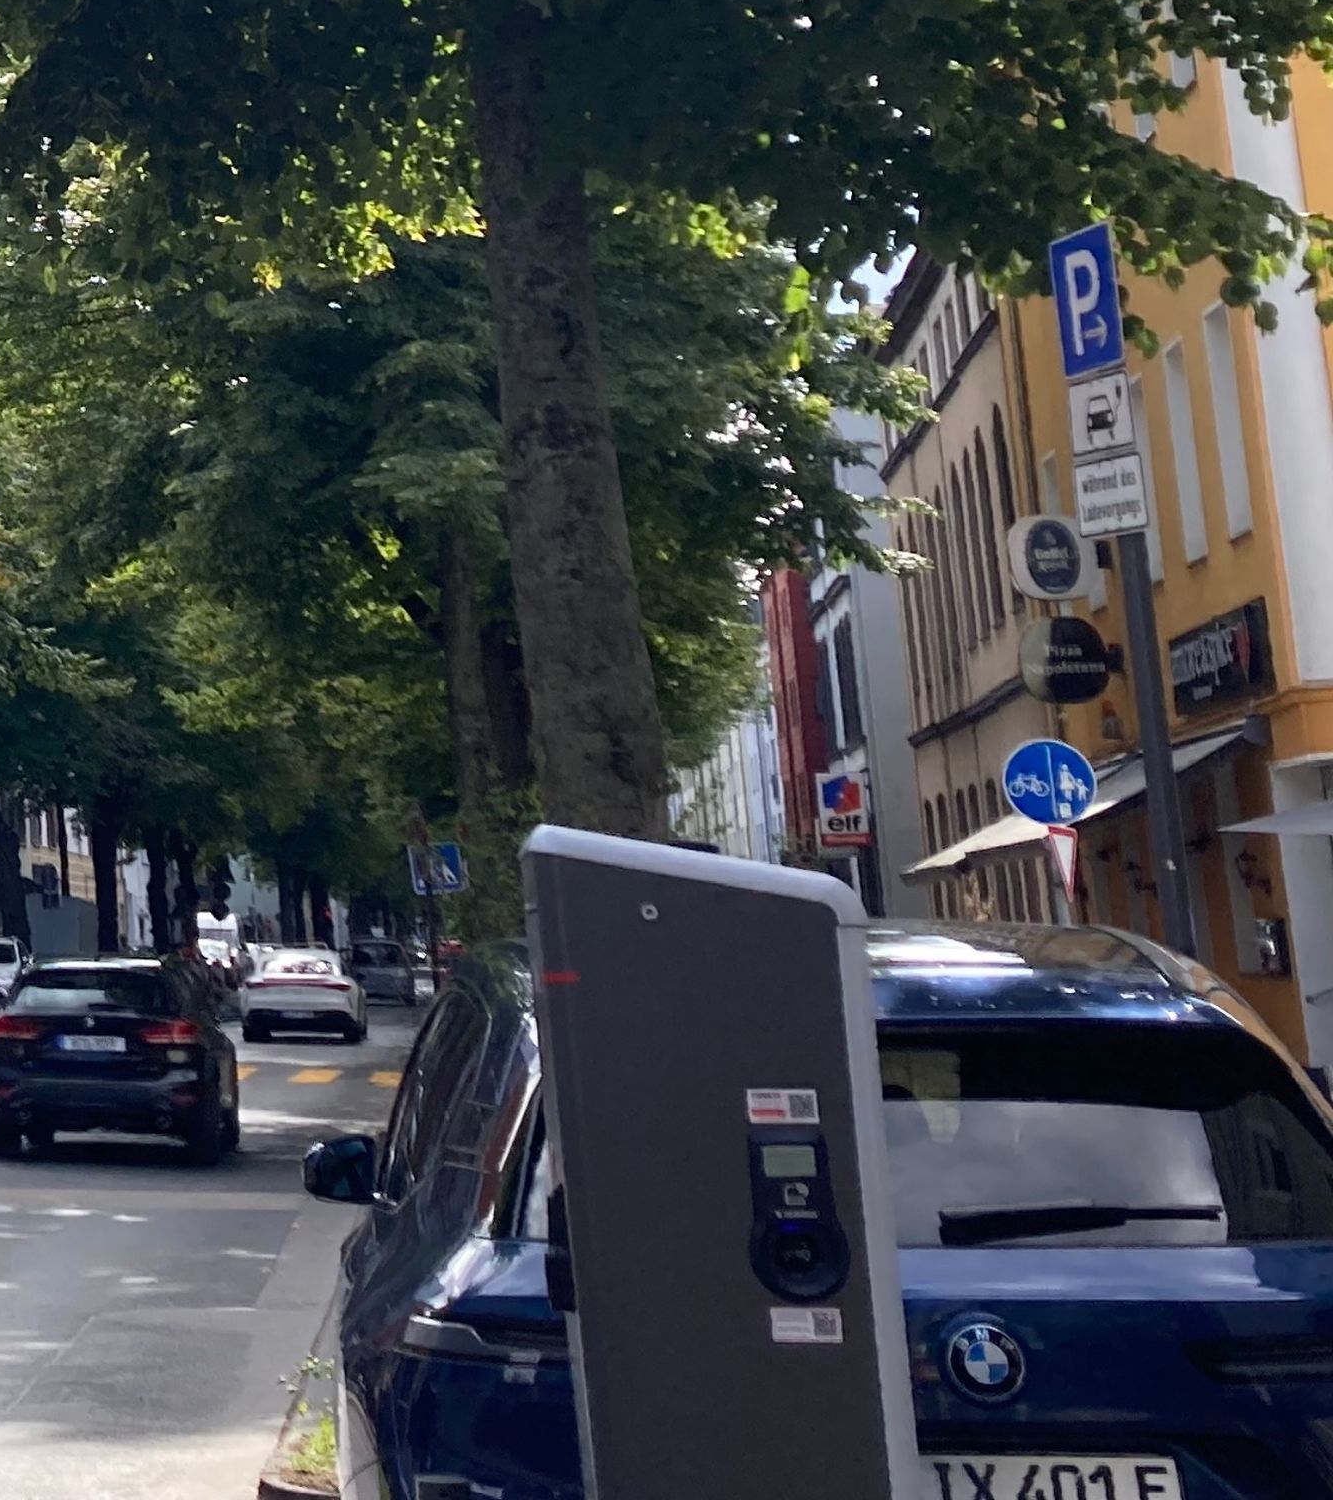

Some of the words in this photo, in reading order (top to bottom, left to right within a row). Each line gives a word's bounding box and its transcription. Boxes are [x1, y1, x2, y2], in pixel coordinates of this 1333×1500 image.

[1064, 249, 1101, 357] P
[1082, 472, 1118, 495] während
[1120, 468, 1138, 487] des
[827, 814, 862, 832] elf
